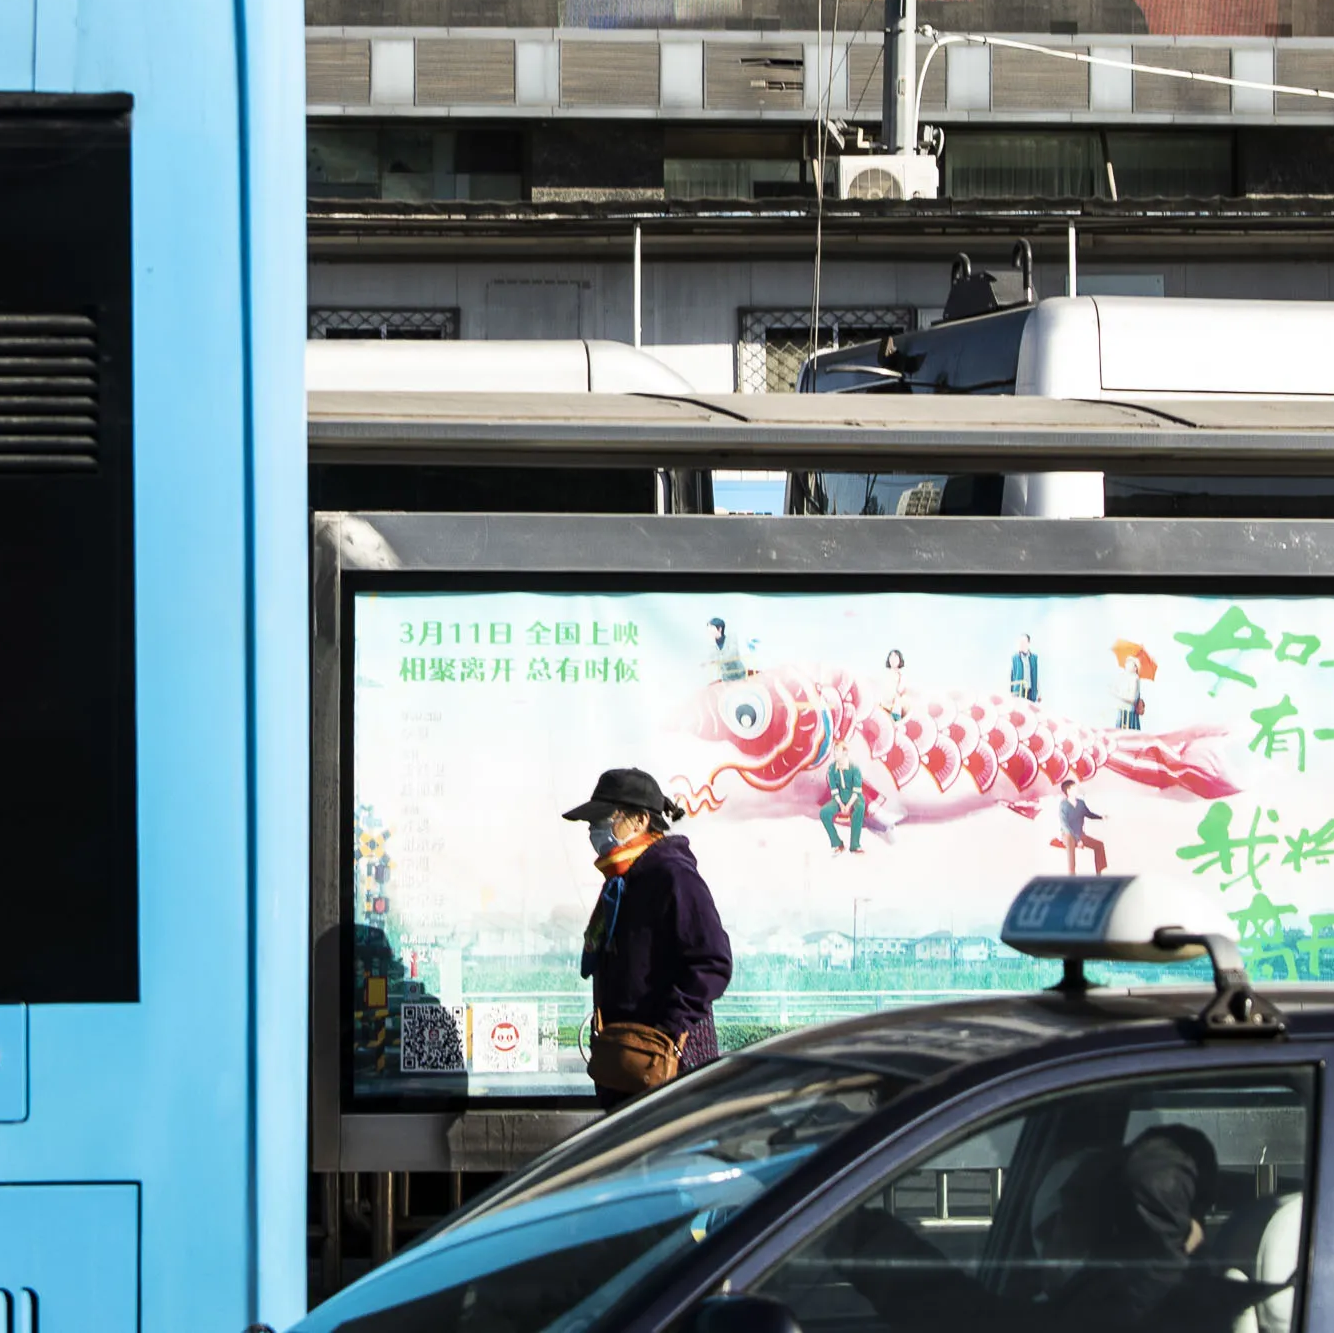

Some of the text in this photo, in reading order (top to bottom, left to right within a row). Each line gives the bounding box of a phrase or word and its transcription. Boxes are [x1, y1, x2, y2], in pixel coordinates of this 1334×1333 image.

[400, 621, 640, 646] 3月11日 全国上映
[399, 656, 641, 683] 相聚离开 总有时候
